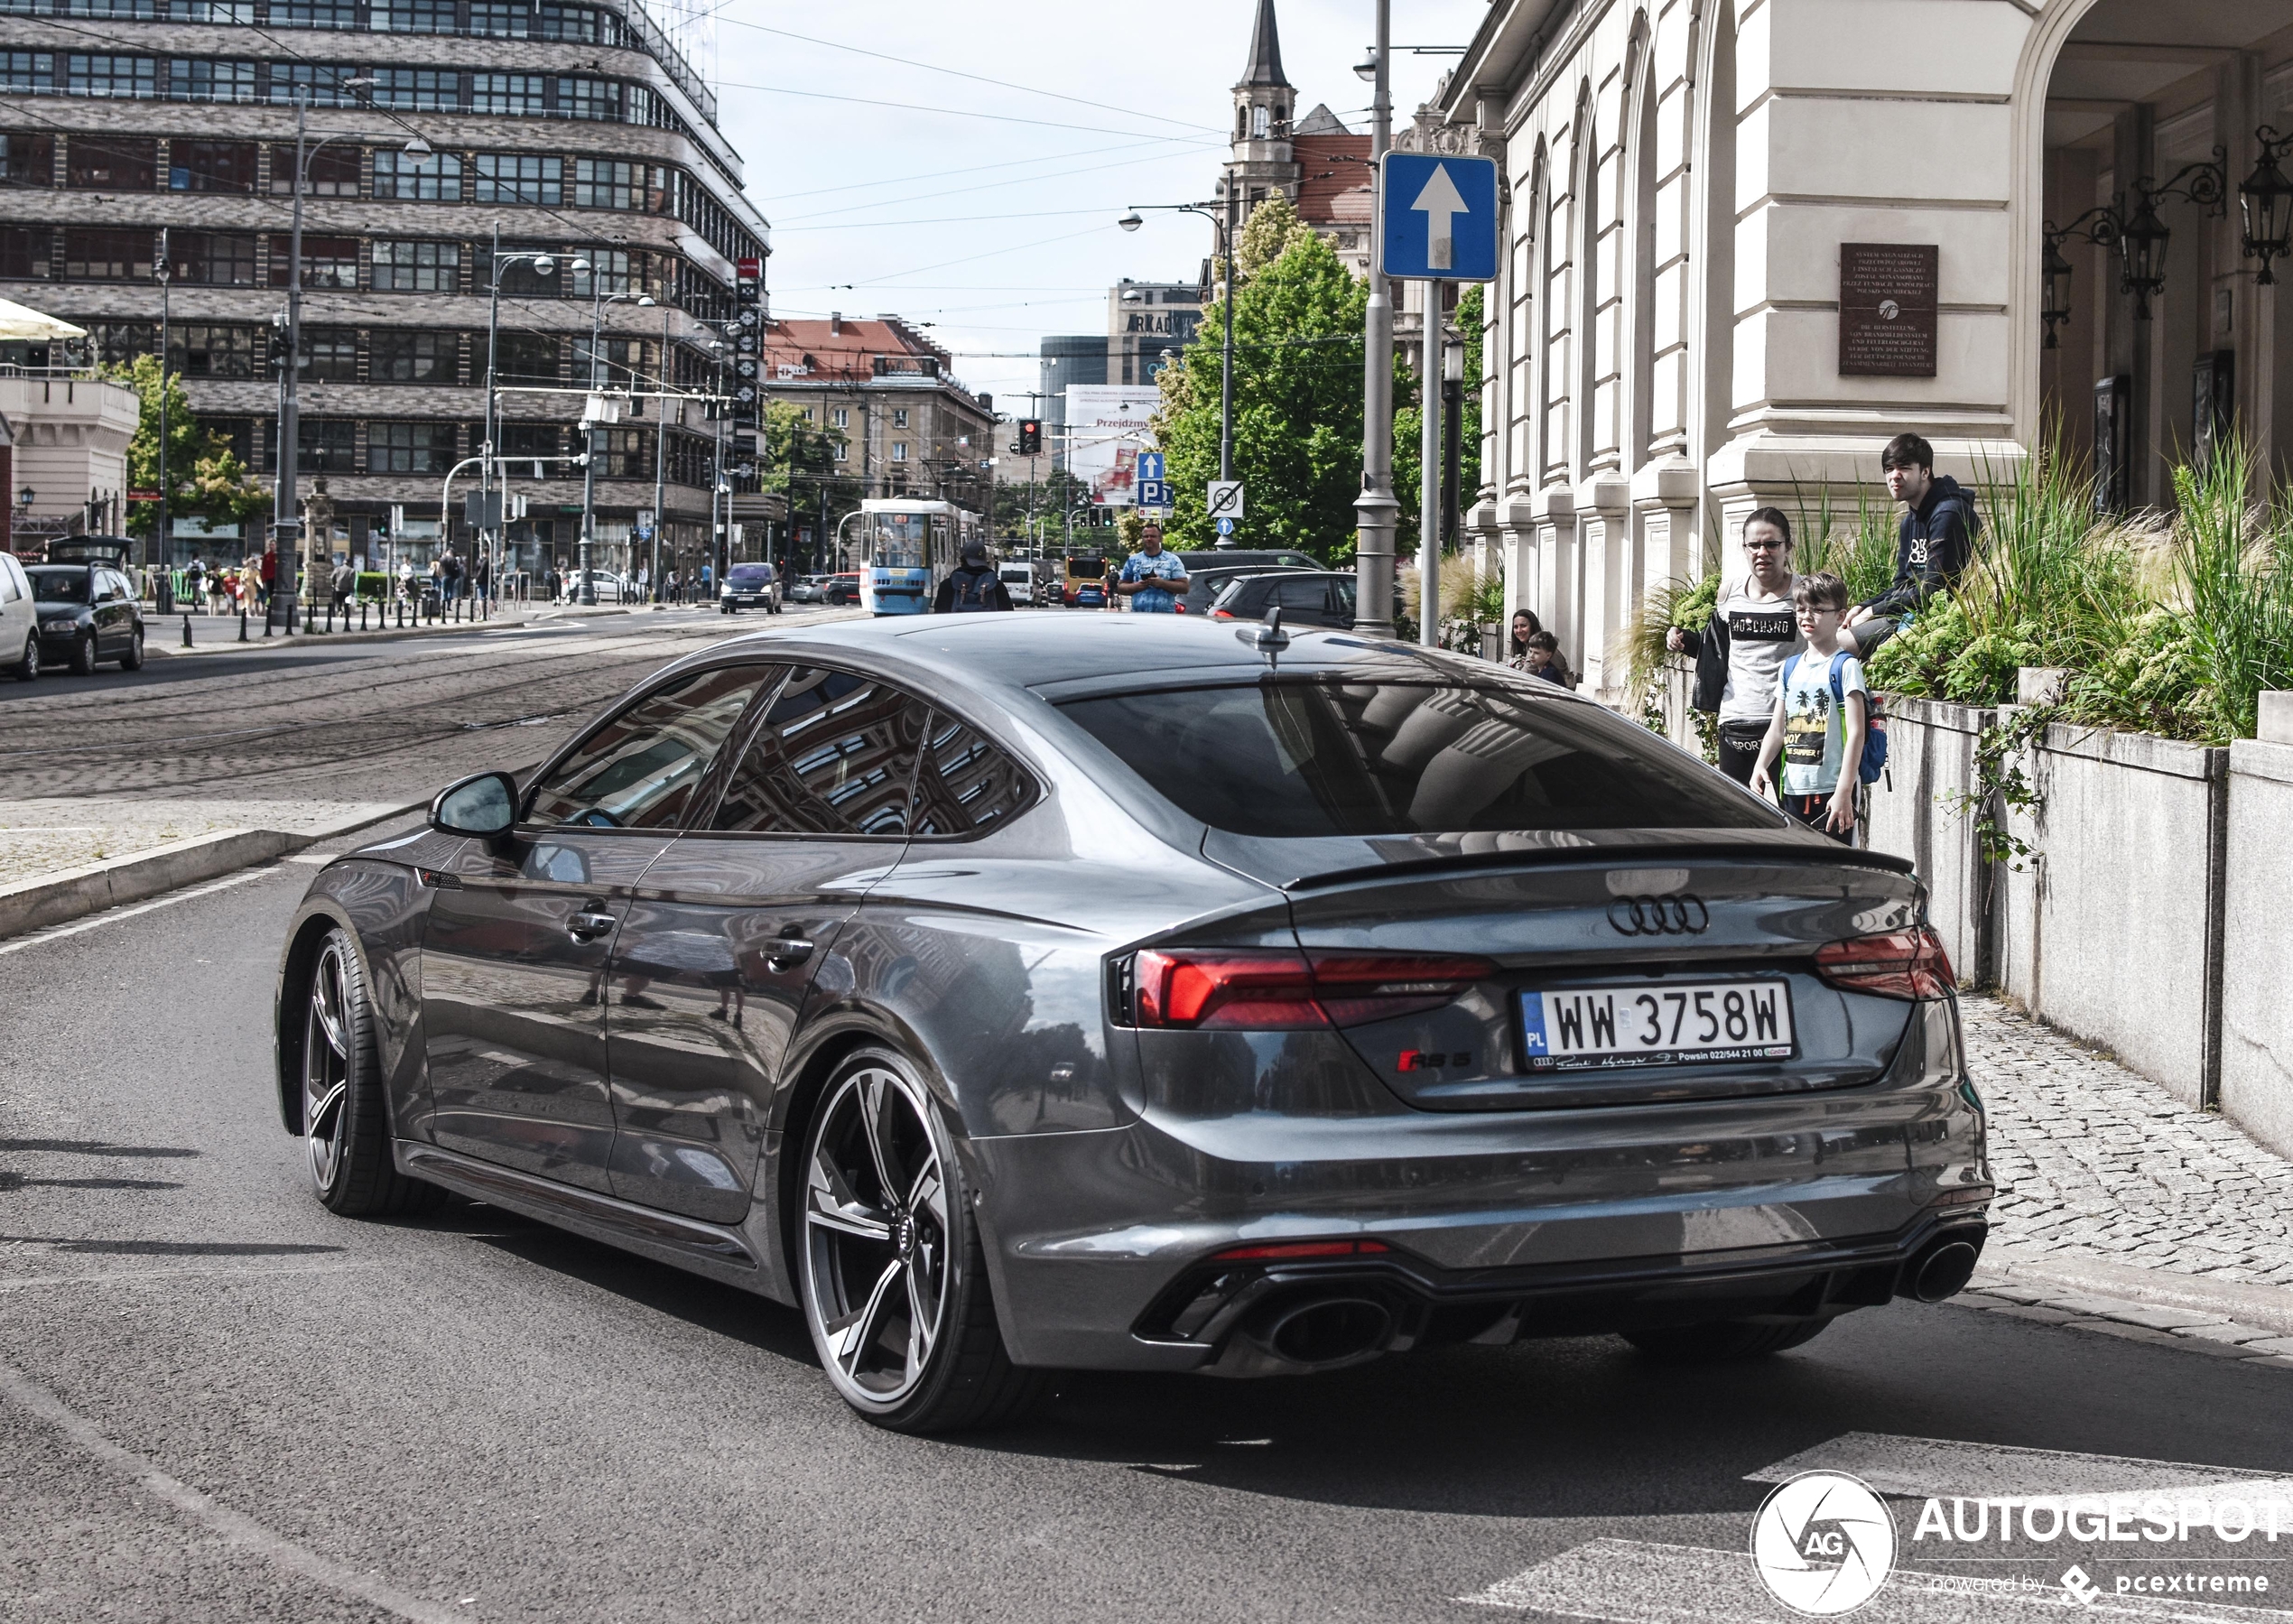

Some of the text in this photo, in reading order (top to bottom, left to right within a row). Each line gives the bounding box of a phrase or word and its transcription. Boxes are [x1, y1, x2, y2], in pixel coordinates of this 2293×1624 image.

[1143, 482, 1158, 503] P
[1554, 988, 1779, 1050] WW 3758W
[1527, 1032, 1546, 1048] PL
[1678, 1048, 1763, 1062] Powsin 022/544 21 00
